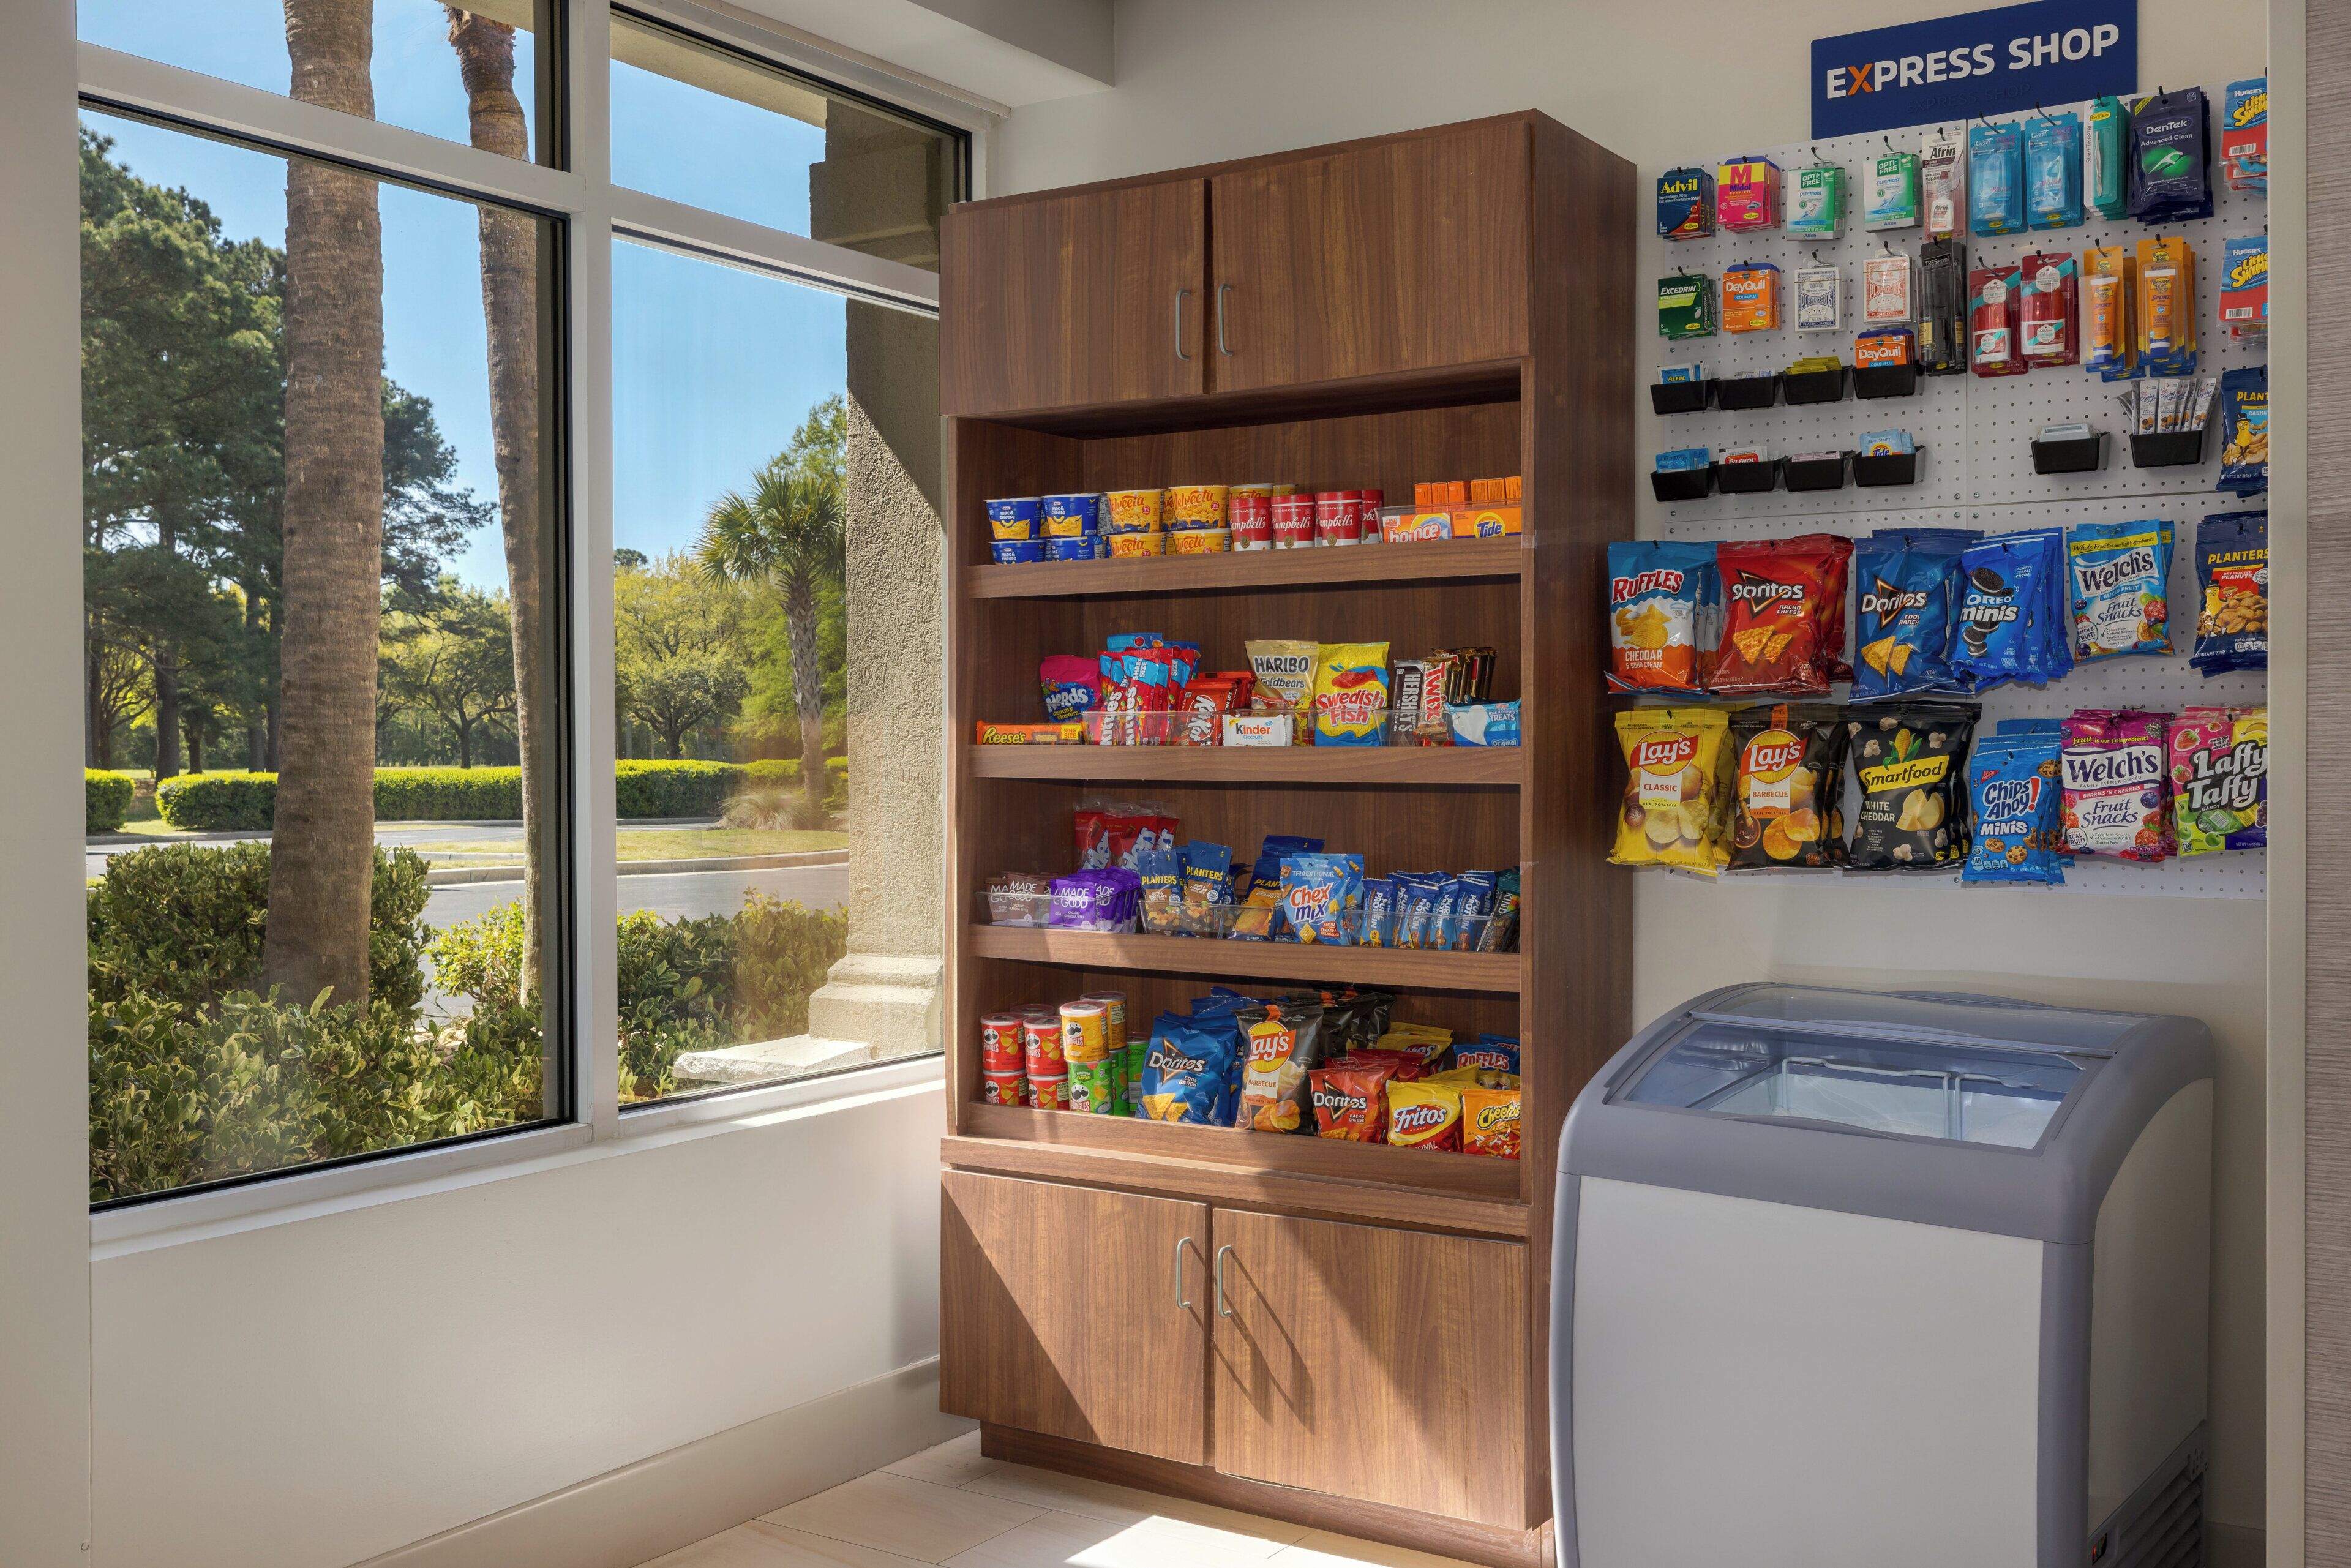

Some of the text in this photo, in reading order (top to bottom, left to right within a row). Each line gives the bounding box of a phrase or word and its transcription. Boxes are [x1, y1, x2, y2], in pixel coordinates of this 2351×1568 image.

[1827, 24, 2119, 99] EXPRESS SHOP
[1905, 83, 2031, 114] EXPRESS SHOP
[2234, 88, 2263, 97] HUGGIES
[2146, 119, 2188, 135] DenTek
[2140, 137, 2173, 147] Advanced
[1930, 146, 1956, 159] Afrin
[1878, 160, 1897, 170] OPTI-
[1878, 166, 1897, 175] FREE
[1660, 178, 1698, 194] Advil
[1730, 183, 1751, 192] Midol
[1802, 179, 1820, 187] FREE
[2233, 247, 2262, 256] HUGGIES
[1924, 256, 1951, 267] TRESemmé
[1660, 285, 1697, 296] EXCEDRIN
[1725, 279, 1766, 294] DayQuil
[1859, 346, 1901, 361] DayQuil
[1872, 446, 1890, 457] Tide
[1273, 516, 1310, 531] Campbell's
[1477, 520, 1502, 538] Tide
[2079, 551, 2154, 592] Welch's
[1612, 569, 1684, 605] RUFFLES
[1731, 582, 1805, 601] Doritos
[2104, 589, 2120, 599] MIXED
[1862, 591, 1927, 613] Doritos
[1967, 595, 2012, 605] OREO
[2107, 597, 2137, 613] Fruit
[1960, 606, 2019, 622] minis
[2096, 607, 2142, 625] Snacks
[2078, 632, 2096, 642] FRUIT!
[1625, 650, 1662, 662] CHEDDAR
[1133, 658, 1143, 680] SHARE
[1254, 656, 1309, 673] HARIBO
[1261, 677, 1305, 688] Goldbears
[1316, 689, 1385, 713] Swedish
[1398, 673, 1422, 732] HERSHEY'S
[1329, 710, 1370, 726] Fish
[2073, 736, 2093, 745] Fruit
[1638, 738, 1690, 765] Lay's
[1749, 741, 1801, 772] Lay's
[2193, 741, 2268, 778] Laffy
[1864, 762, 1943, 787] Smartfood
[2066, 750, 2158, 783] Welch's
[1643, 783, 1678, 792] CLASSIC
[1985, 779, 2030, 806] Chips
[2114, 786, 2140, 795] CHERRIES
[2187, 773, 2258, 808] Taffy
[1865, 801, 1889, 811] WHITE
[2092, 798, 2132, 815] Fruit
[1861, 811, 1895, 822] CHEDDAR
[2081, 810, 2139, 828] Snacks
[1142, 876, 1177, 885] PLANTERS
[1186, 866, 1223, 882] PLANTERS
[1010, 880, 1038, 892] MADE
[1062, 888, 1090, 898] MADE
[1008, 890, 1033, 902] GOOD
[1060, 898, 1088, 909] GOOD
[1291, 884, 1331, 907] Chex
[1498, 892, 1513, 915] KIND
[1295, 901, 1327, 922] mix
[1371, 892, 1384, 929] PROTEIN
[1248, 1031, 1289, 1061] Lay's
[1149, 1052, 1206, 1072] Doritos
[1248, 1079, 1277, 1088] BARBECUE
[1314, 1092, 1367, 1109] Doritos
[1393, 1105, 1447, 1132] Fritos
